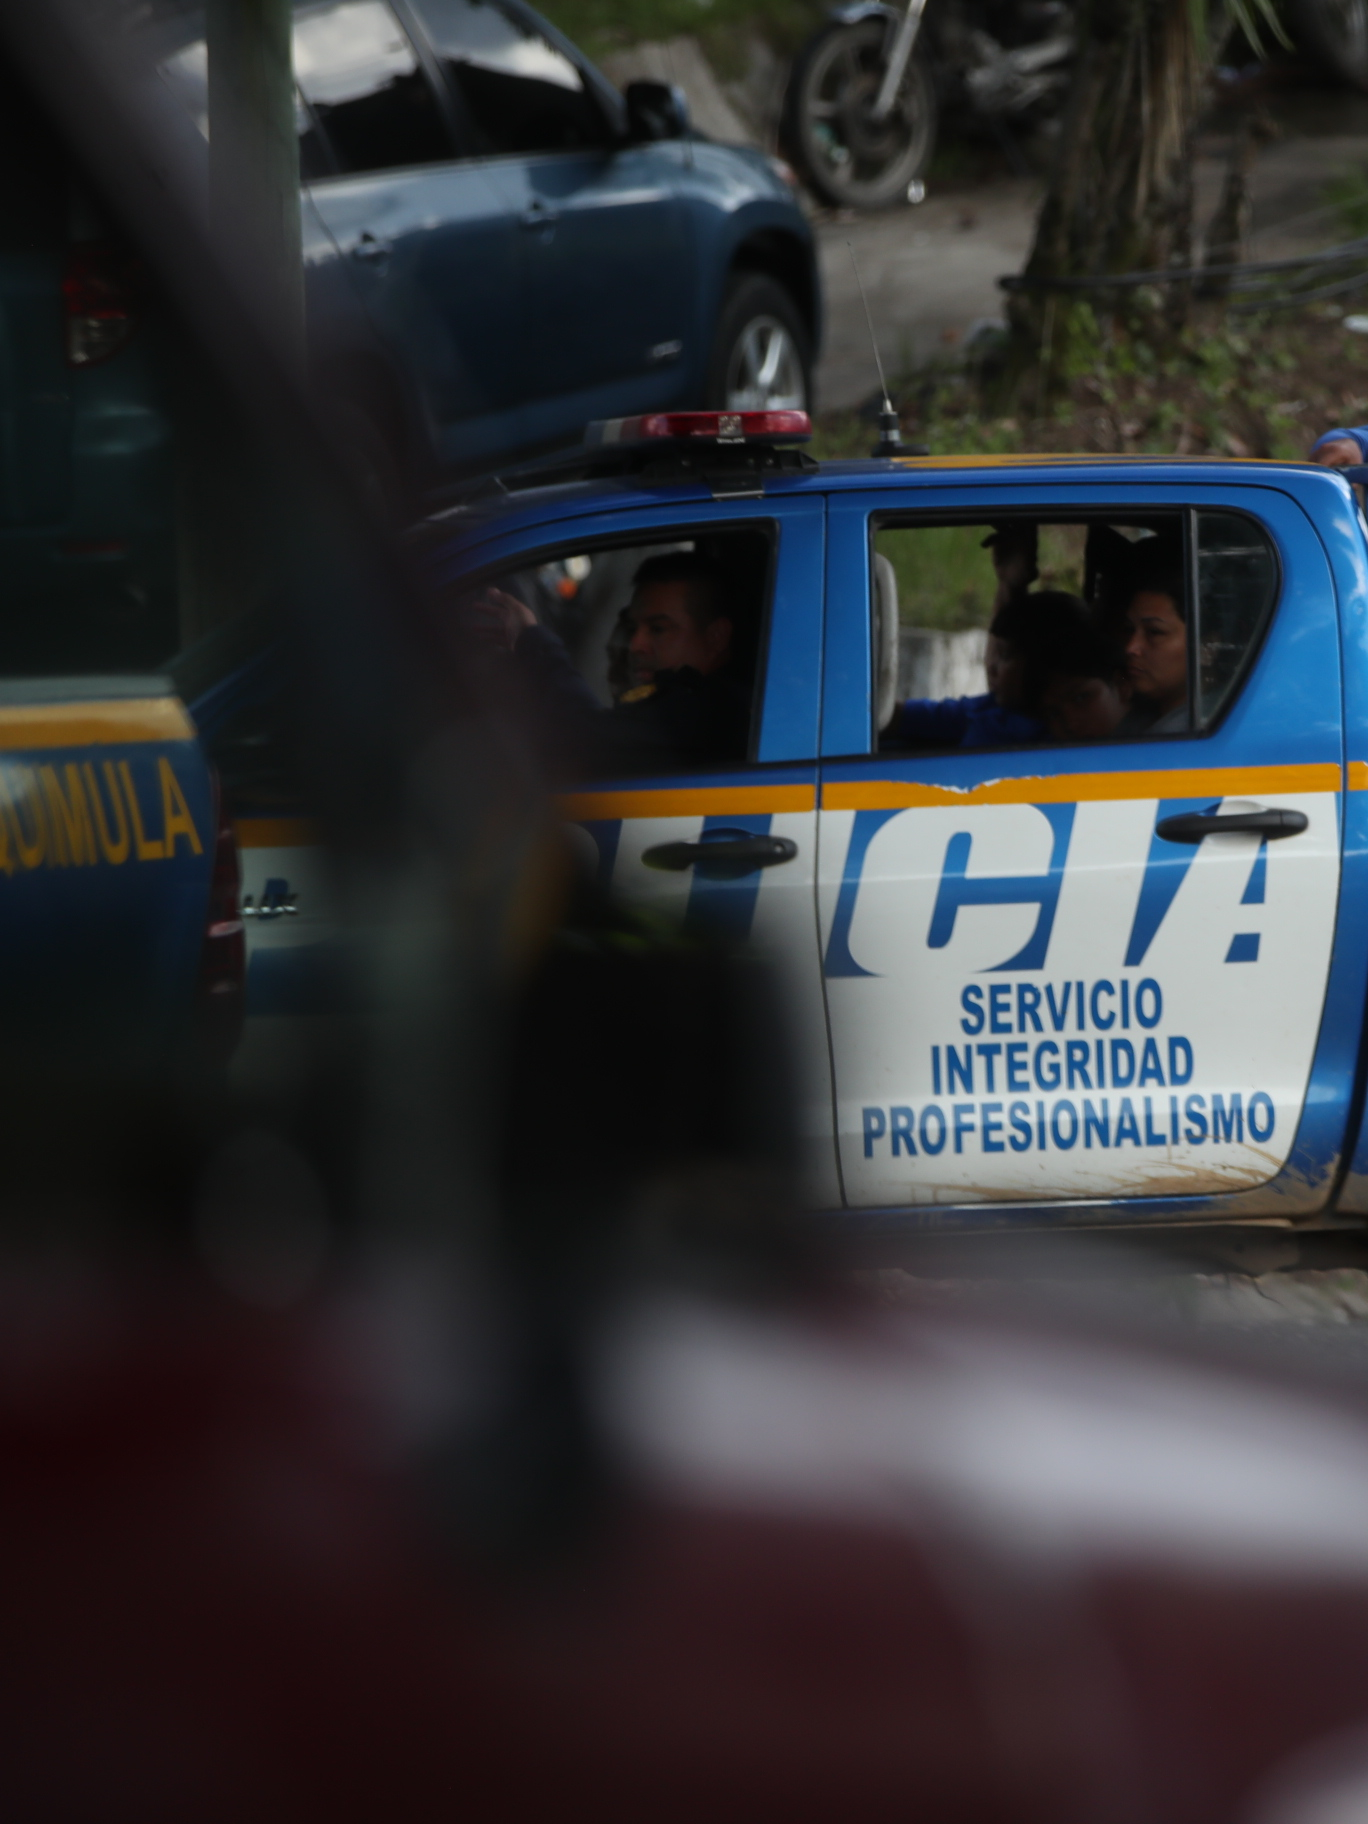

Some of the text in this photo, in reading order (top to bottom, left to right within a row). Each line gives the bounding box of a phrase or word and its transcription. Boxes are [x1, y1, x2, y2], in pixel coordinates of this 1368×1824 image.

[959, 976, 1164, 1036] SERVICIO
[930, 1035, 1194, 1096] INTEGRIDAD
[861, 1090, 1277, 1160] PROFESIONALISMO
